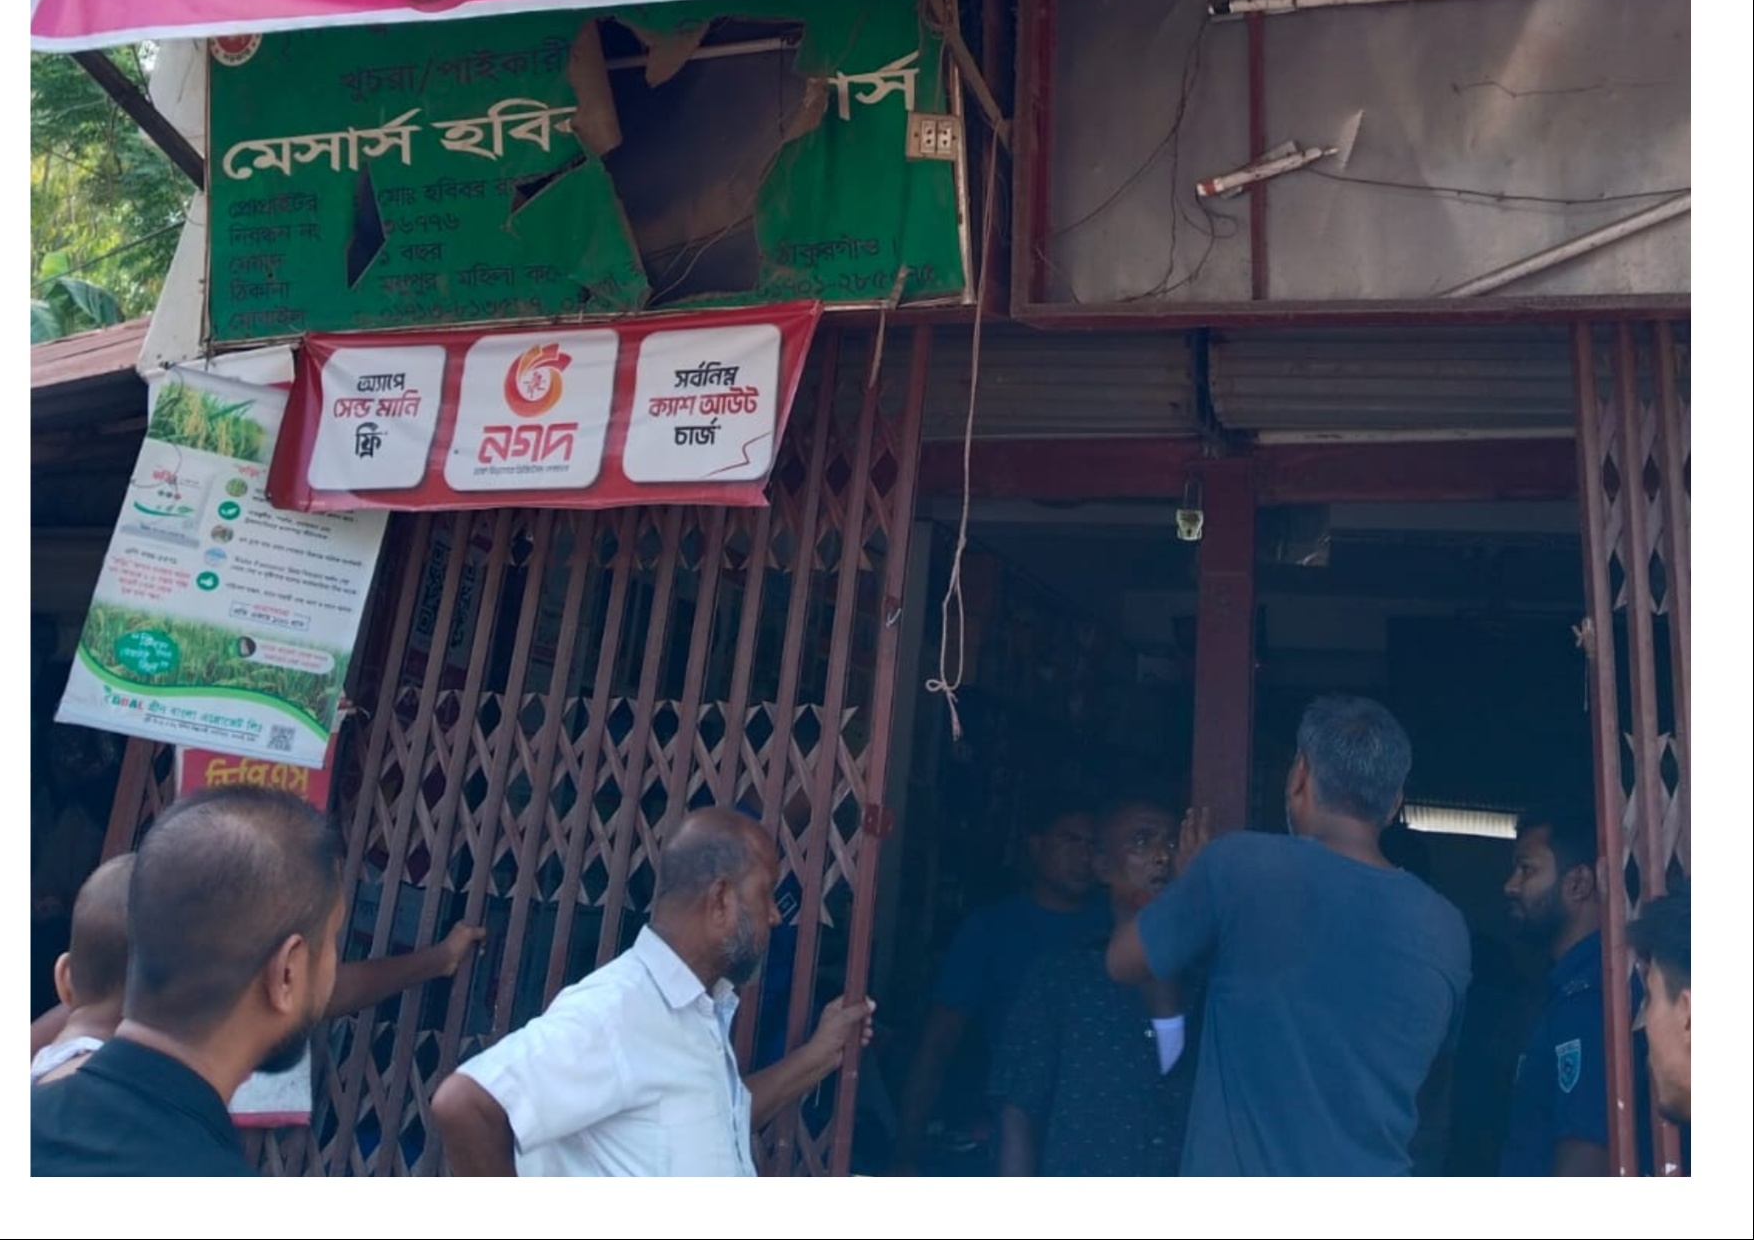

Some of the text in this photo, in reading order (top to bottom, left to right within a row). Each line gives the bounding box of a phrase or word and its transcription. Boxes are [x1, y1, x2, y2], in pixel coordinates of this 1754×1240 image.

[223, 108, 422, 180] মেসার্স
[674, 360, 740, 389] সর্বনিম্ন
[332, 389, 422, 420] সেন্ড মানি
[648, 387, 760, 419] ক্যাশ আউট
[477, 422, 579, 464] নগদ
